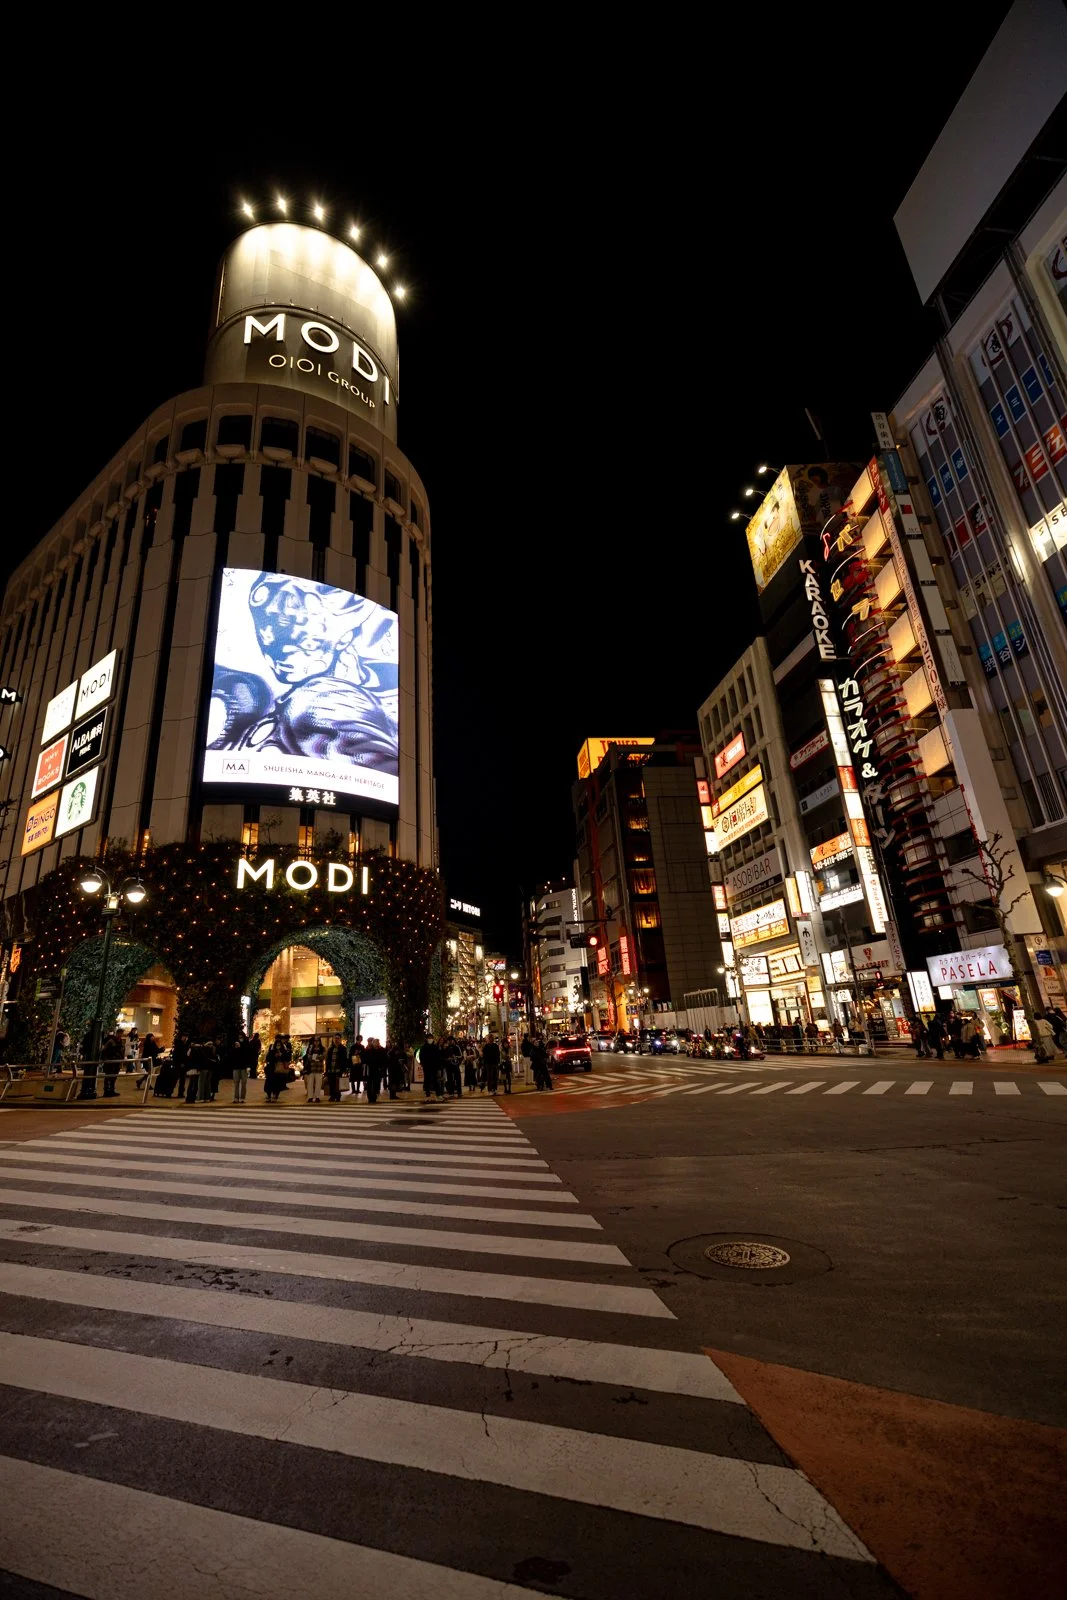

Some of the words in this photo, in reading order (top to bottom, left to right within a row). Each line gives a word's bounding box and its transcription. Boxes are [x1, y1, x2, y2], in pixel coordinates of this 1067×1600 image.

[244, 313, 390, 405] MODI
[327, 371, 376, 408] GROUP
[799, 559, 837, 660] KARAOKE
[80, 668, 111, 702] MODI
[226, 763, 246, 771] MA
[263, 764, 304, 774] SHUEISHA
[306, 770, 352, 781] MANGA-ART
[354, 777, 385, 790] HERITAGE
[289, 787, 337, 805] 集英社
[236, 858, 369, 895] MODI
[732, 858, 772, 889] ASOBIBAR
[941, 960, 998, 981] PASELA
